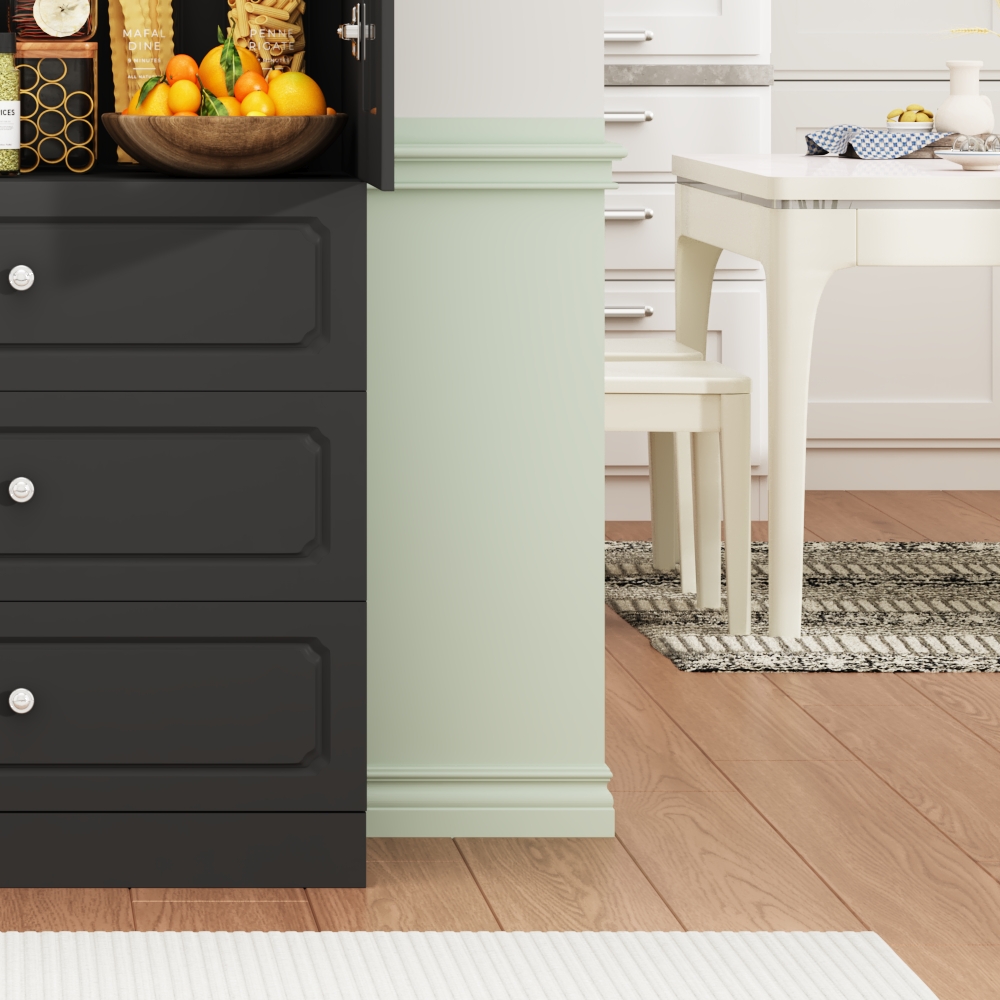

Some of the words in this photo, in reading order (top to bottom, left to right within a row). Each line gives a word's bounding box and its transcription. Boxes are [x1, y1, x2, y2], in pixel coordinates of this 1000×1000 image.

[122, 29, 166, 38] MAFAL
[250, 28, 293, 38] PENNE
[128, 41, 161, 51] DINE
[249, 41, 295, 51] RIGATE
